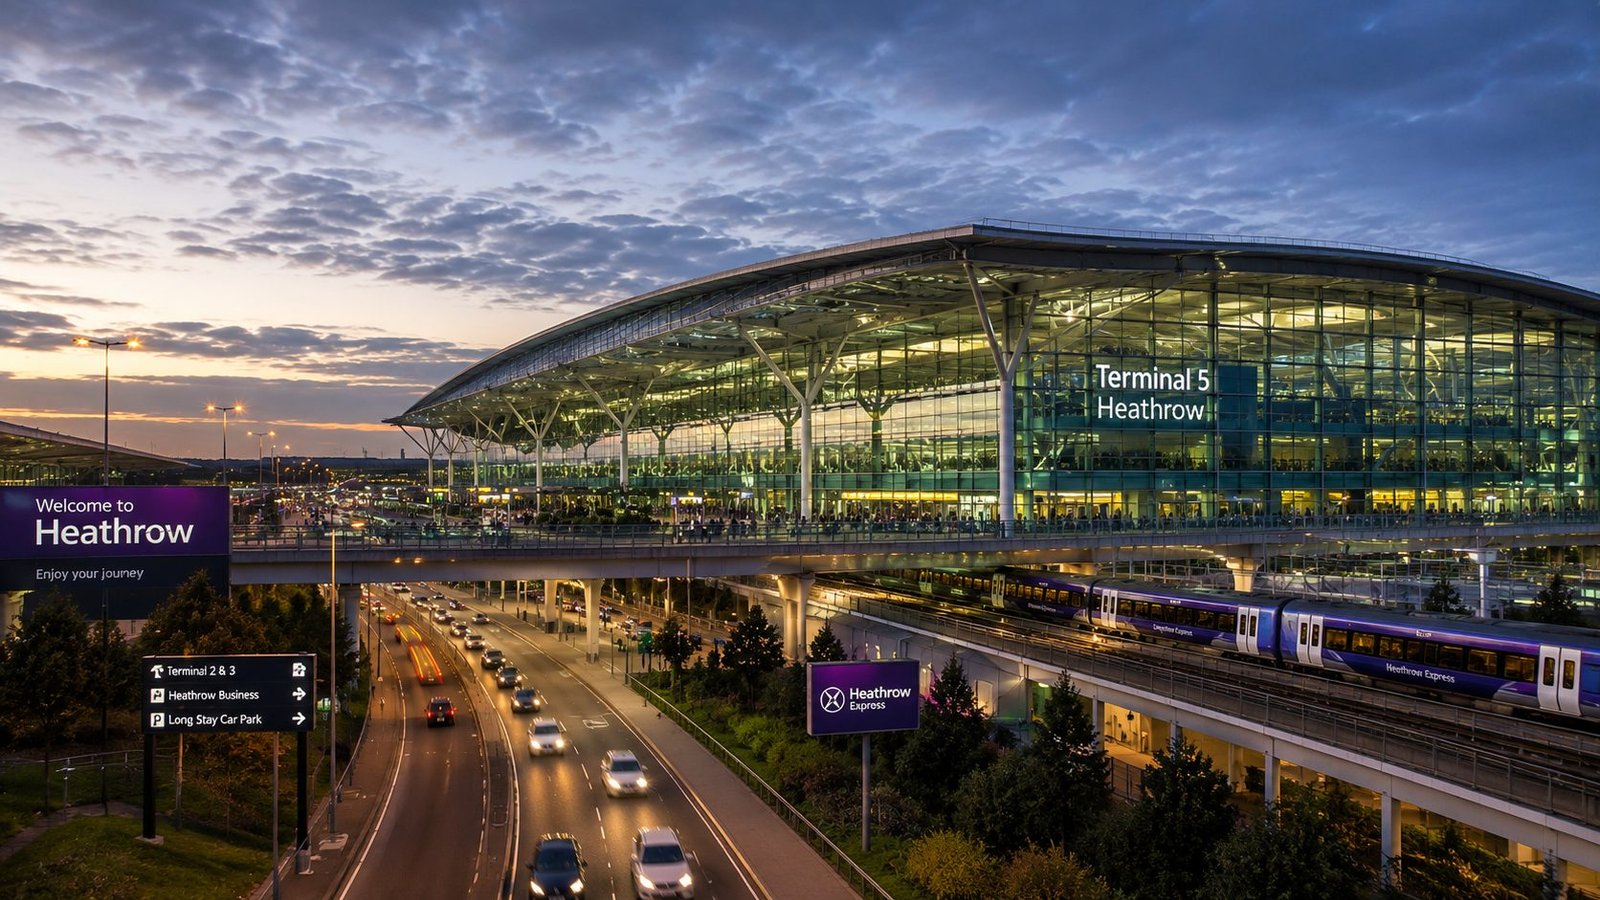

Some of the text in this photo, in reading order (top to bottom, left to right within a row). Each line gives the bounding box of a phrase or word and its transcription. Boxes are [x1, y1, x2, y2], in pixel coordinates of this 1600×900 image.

[1096, 364, 1210, 391] Terminal 5
[1098, 396, 1204, 420] Heathrow
[36, 499, 134, 513] Welcome to
[36, 517, 194, 545] Heathrow
[36, 568, 68, 581] Enjoy
[72, 571, 98, 581] your
[167, 665, 236, 676] Terminal 2 & 3
[1424, 670, 1455, 684] Express
[168, 689, 260, 701] Heathrow Business
[850, 686, 911, 700] Heathrow
[850, 701, 886, 712] Express
[168, 713, 262, 727] Long Stay Car Park
